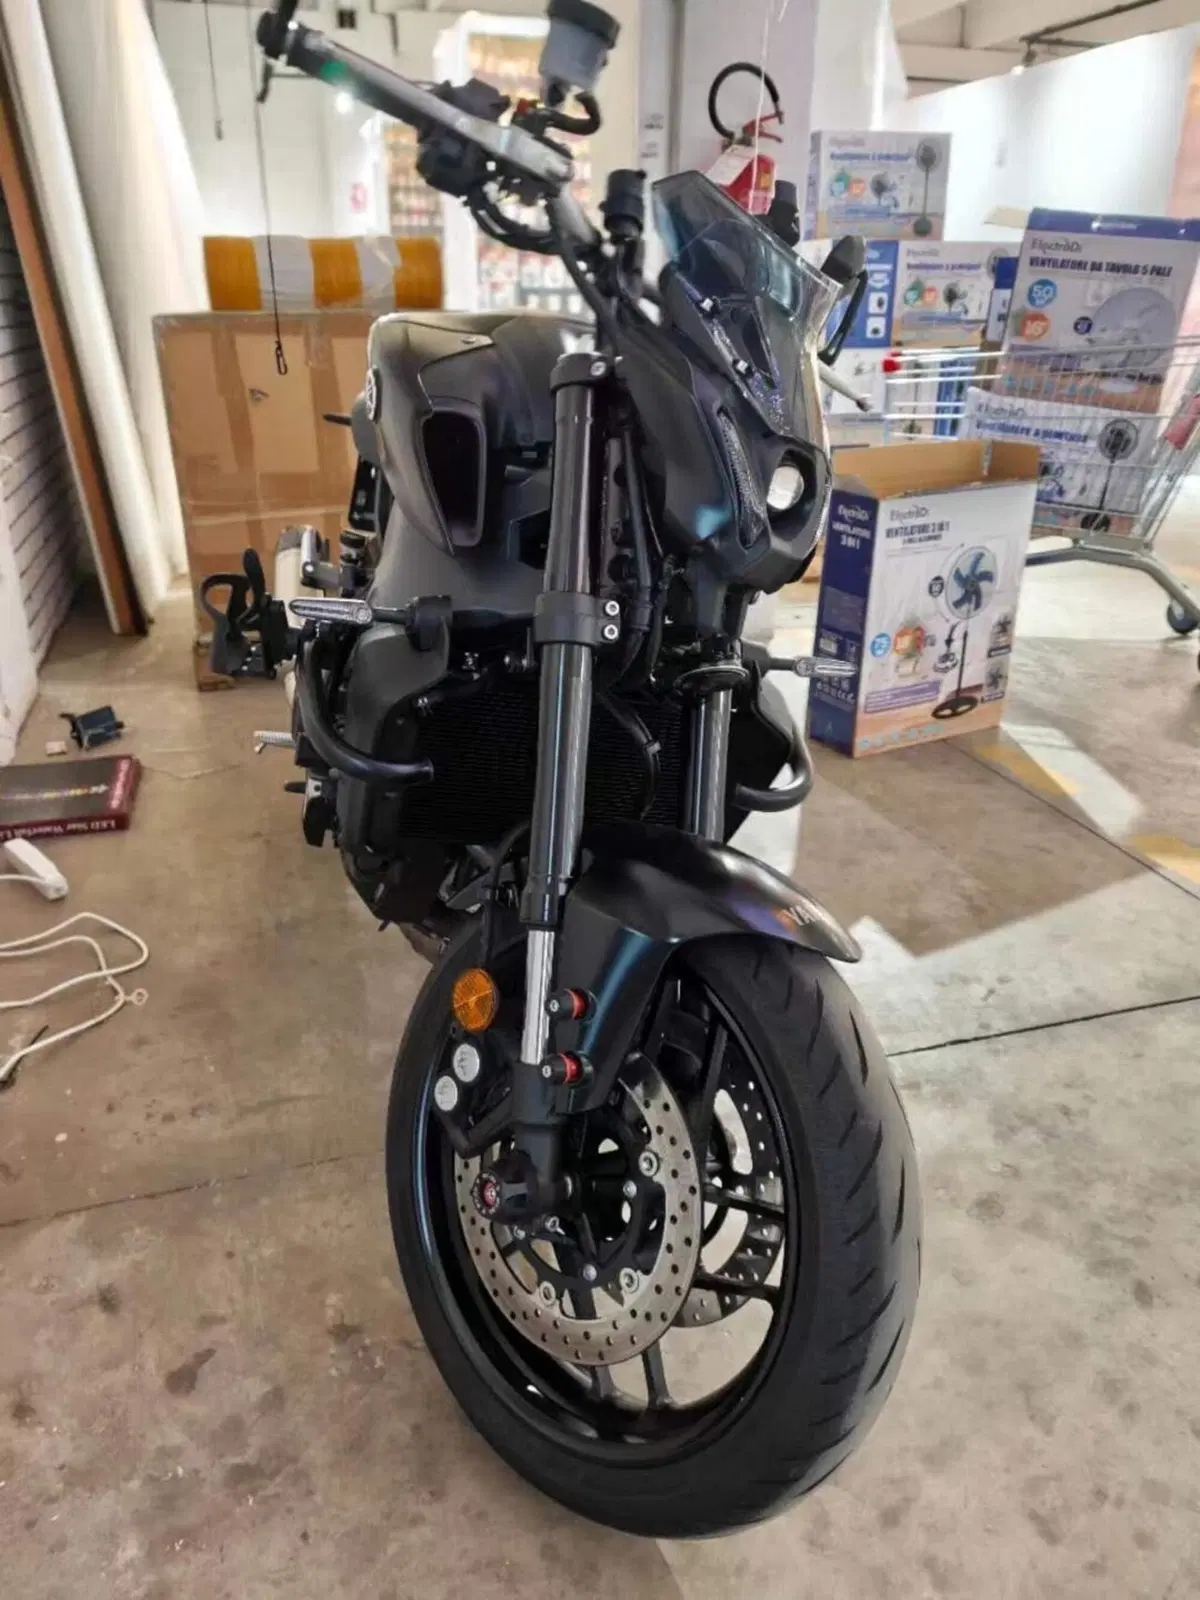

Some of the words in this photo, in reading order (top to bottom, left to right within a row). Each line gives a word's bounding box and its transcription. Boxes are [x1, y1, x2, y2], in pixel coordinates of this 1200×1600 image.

[1029, 256, 1088, 271] VENTILATORE
[1104, 262, 1139, 275] TAVOLO
[1142, 264, 1149, 275] 5
[1150, 265, 1173, 278] PALE
